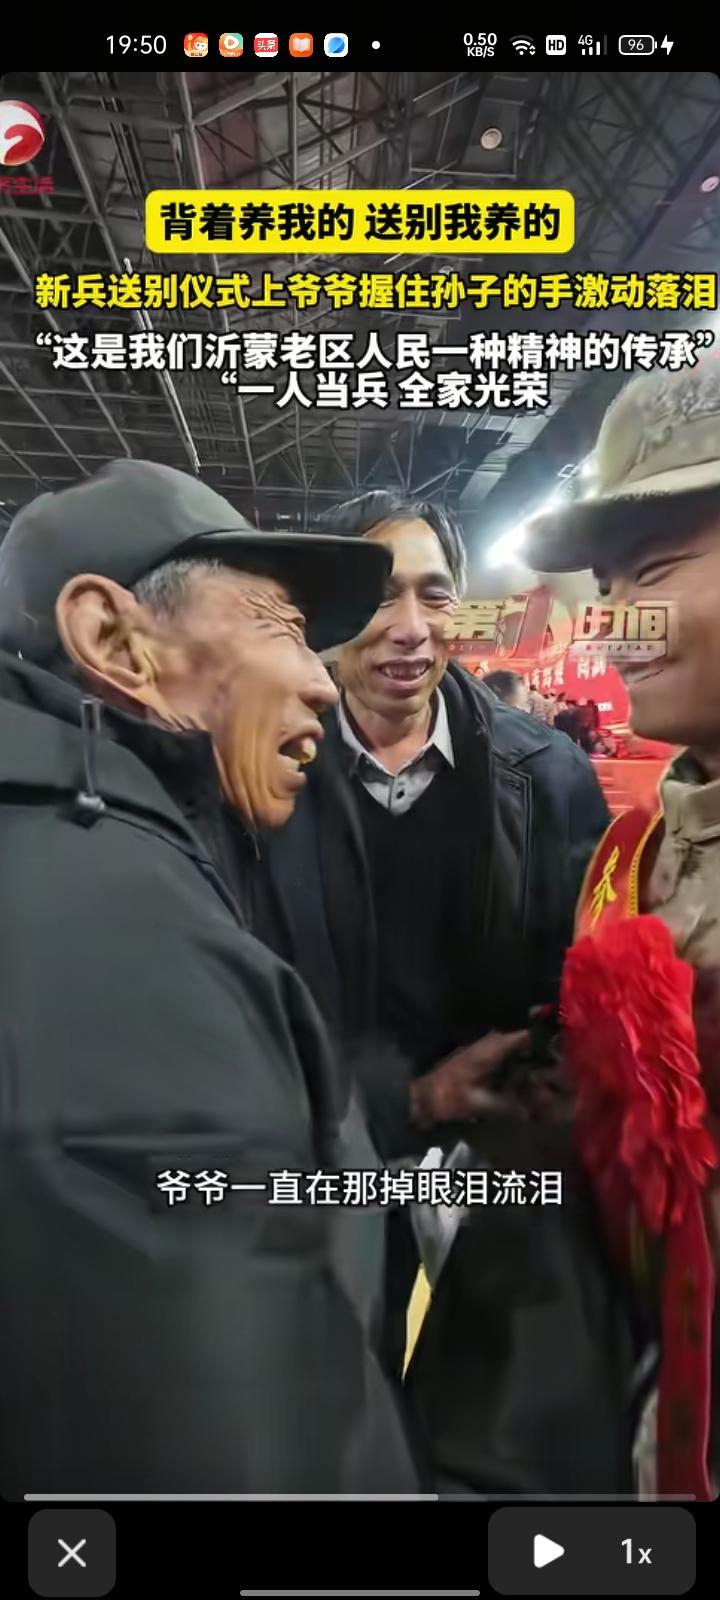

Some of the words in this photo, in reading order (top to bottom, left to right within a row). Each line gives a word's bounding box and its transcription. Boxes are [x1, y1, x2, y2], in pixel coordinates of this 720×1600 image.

[106, 35, 167, 55] 19:50
[256, 39, 276, 51] 头条
[463, 32, 498, 46] 0.50
[548, 39, 565, 51] HD
[577, 34, 593, 46] 4G
[627, 38, 645, 51] 96
[467, 46, 495, 57] KB/S
[621, 1538, 652, 1564] 1x
